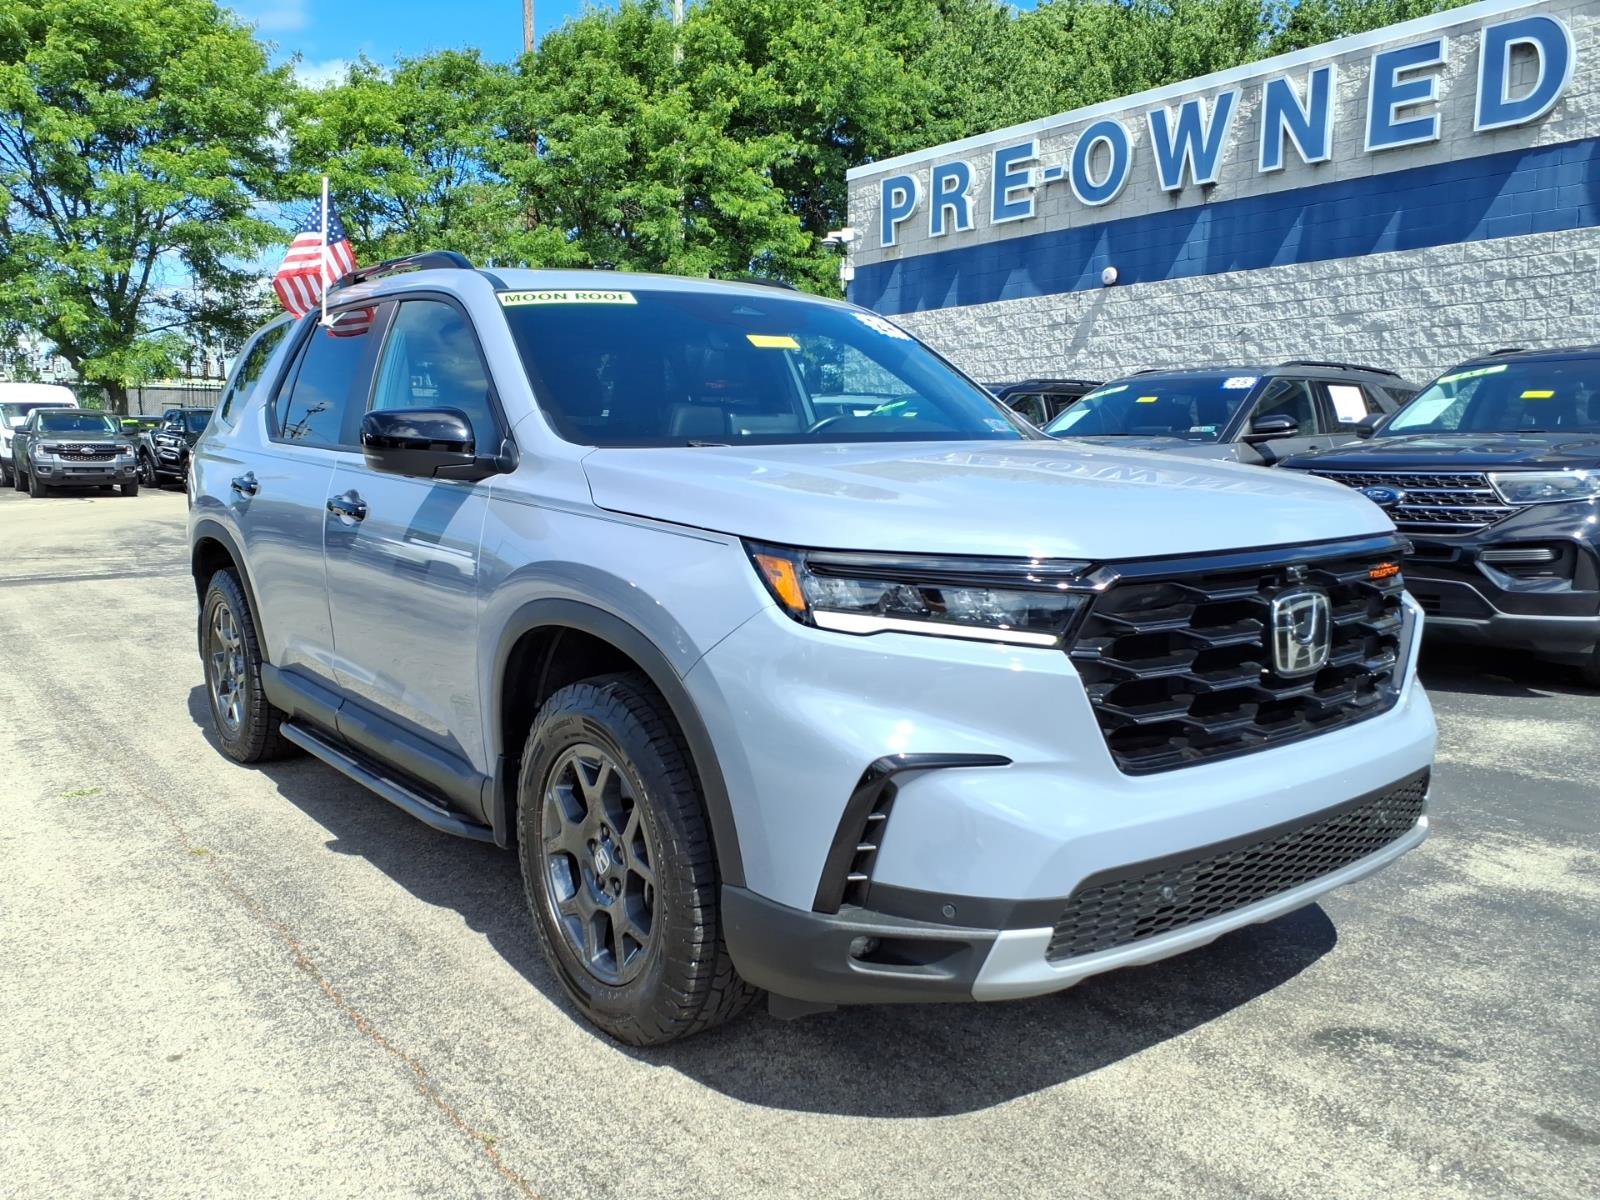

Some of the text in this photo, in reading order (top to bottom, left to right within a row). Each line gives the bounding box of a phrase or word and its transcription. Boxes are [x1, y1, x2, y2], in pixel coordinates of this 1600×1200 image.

[879, 14, 1577, 248] PRE-OWNED
[504, 292, 628, 303] MOON ROOF
